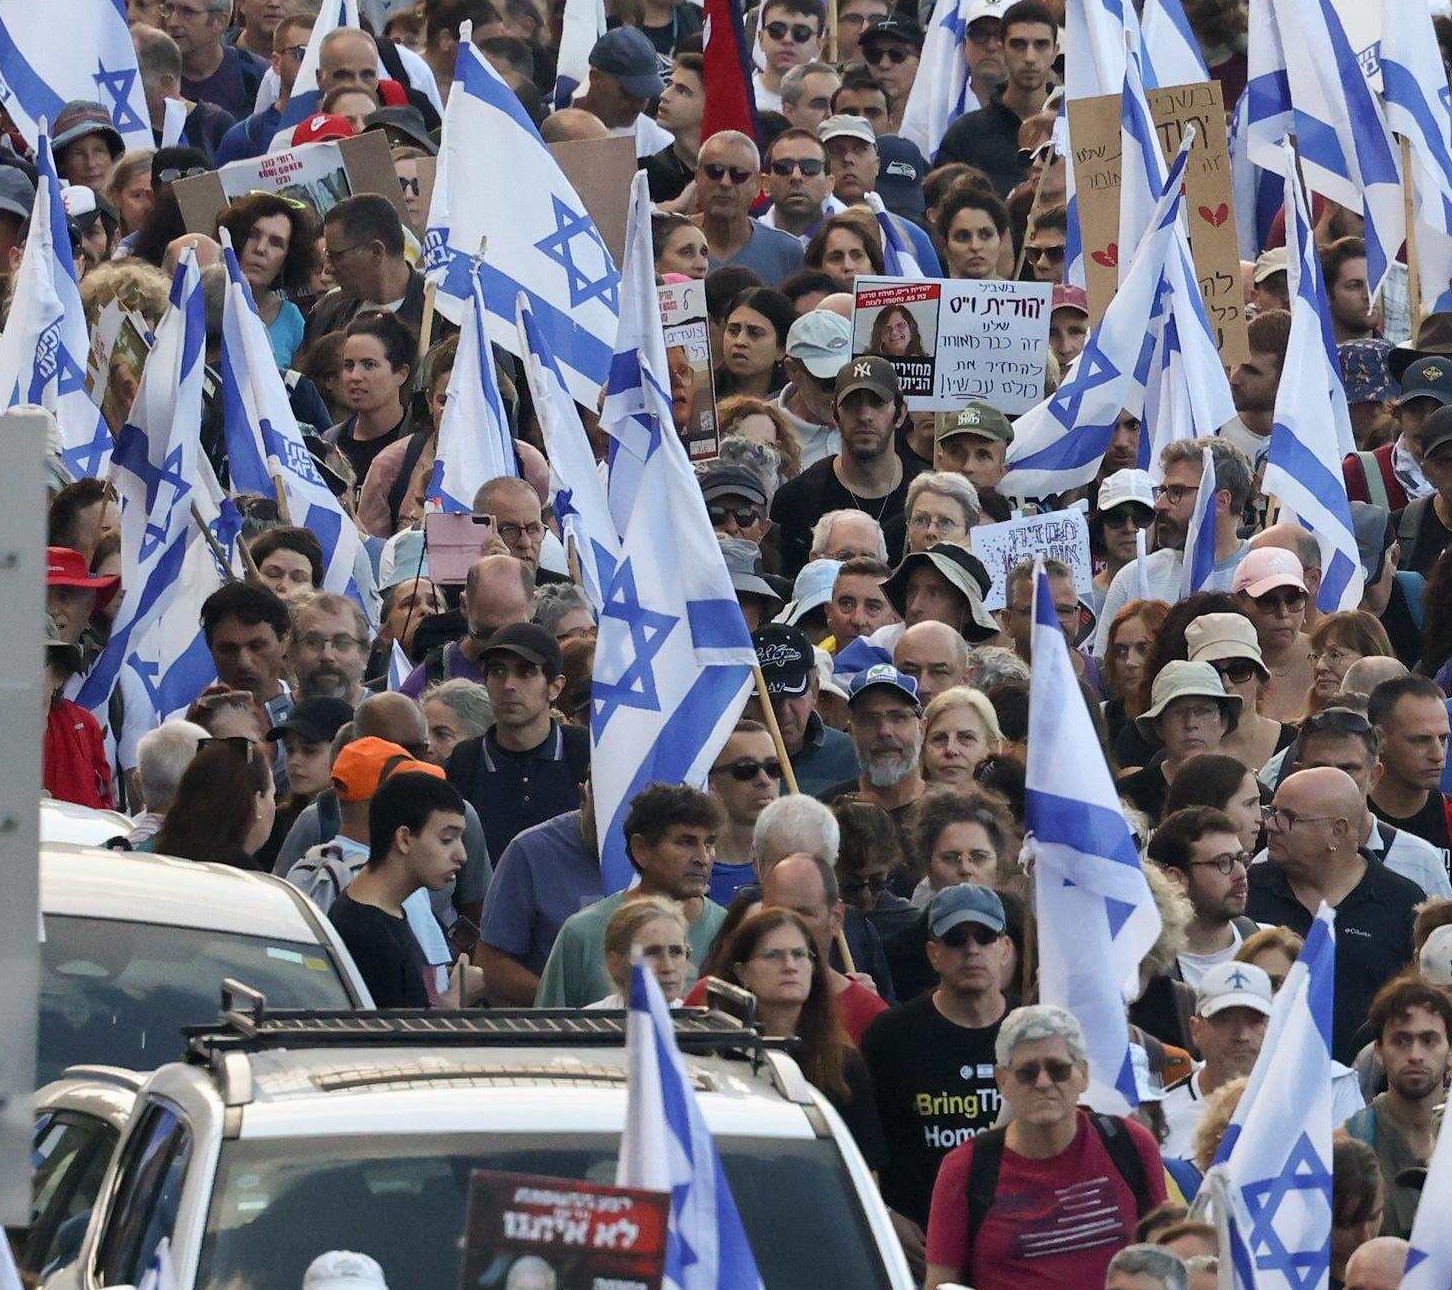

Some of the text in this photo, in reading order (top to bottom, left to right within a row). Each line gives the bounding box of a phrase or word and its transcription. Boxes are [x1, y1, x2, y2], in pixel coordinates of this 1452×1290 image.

[258, 162, 304, 178] ROMI GONEN
[275, 175, 291, 184] (23)
[978, 283, 1016, 293] בשביל
[980, 297, 1044, 319] יהודית
[982, 321, 1009, 332] שלנו
[984, 336, 1041, 351] זה כבר
[853, 361, 871, 377] NY
[954, 360, 1042, 376] להחזיר את
[1001, 381, 1037, 398] כולם
[502, 1212, 642, 1251] לא איתנו
